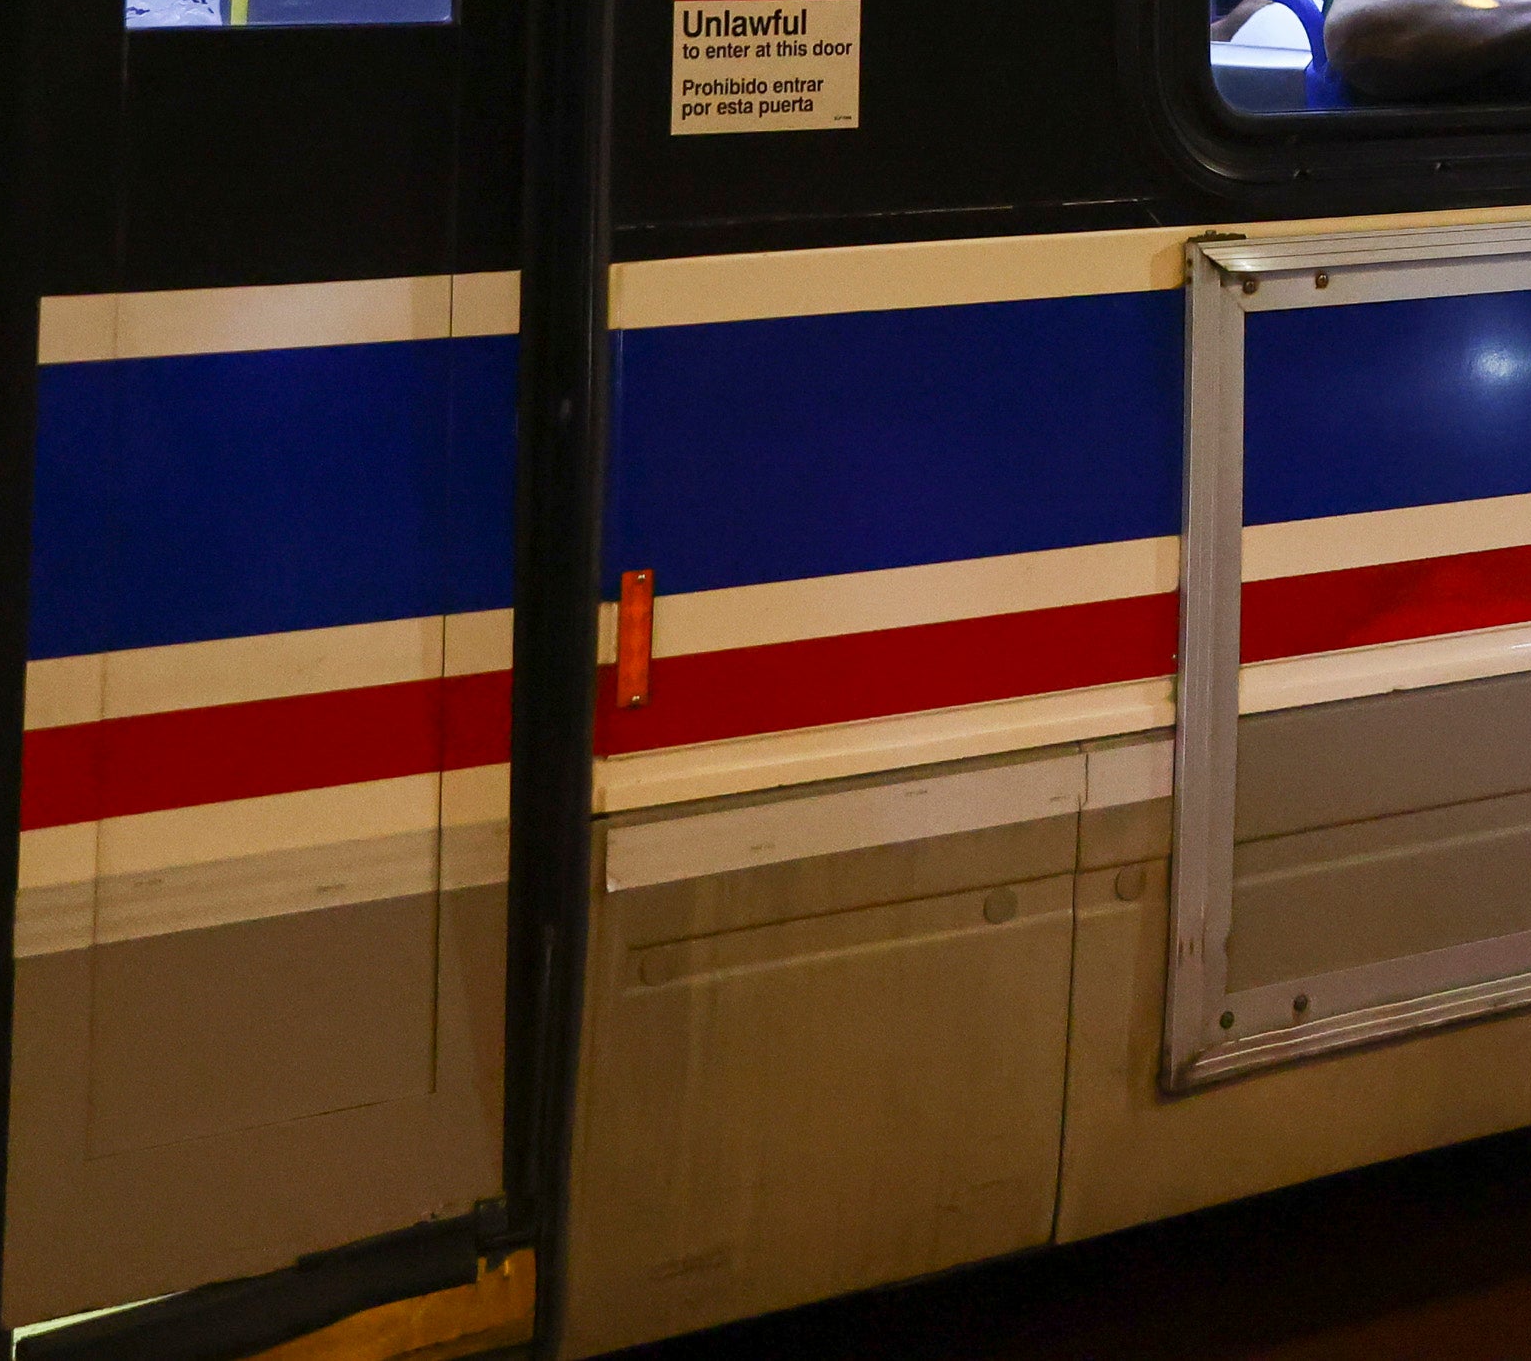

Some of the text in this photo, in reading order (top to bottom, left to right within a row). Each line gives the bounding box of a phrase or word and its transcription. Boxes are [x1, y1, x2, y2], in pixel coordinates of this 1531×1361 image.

[682, 9, 807, 38] Unlawful
[682, 40, 853, 60] to enter at this door
[682, 77, 824, 97] Prohibido entrar
[681, 96, 814, 120] por esta puerta
